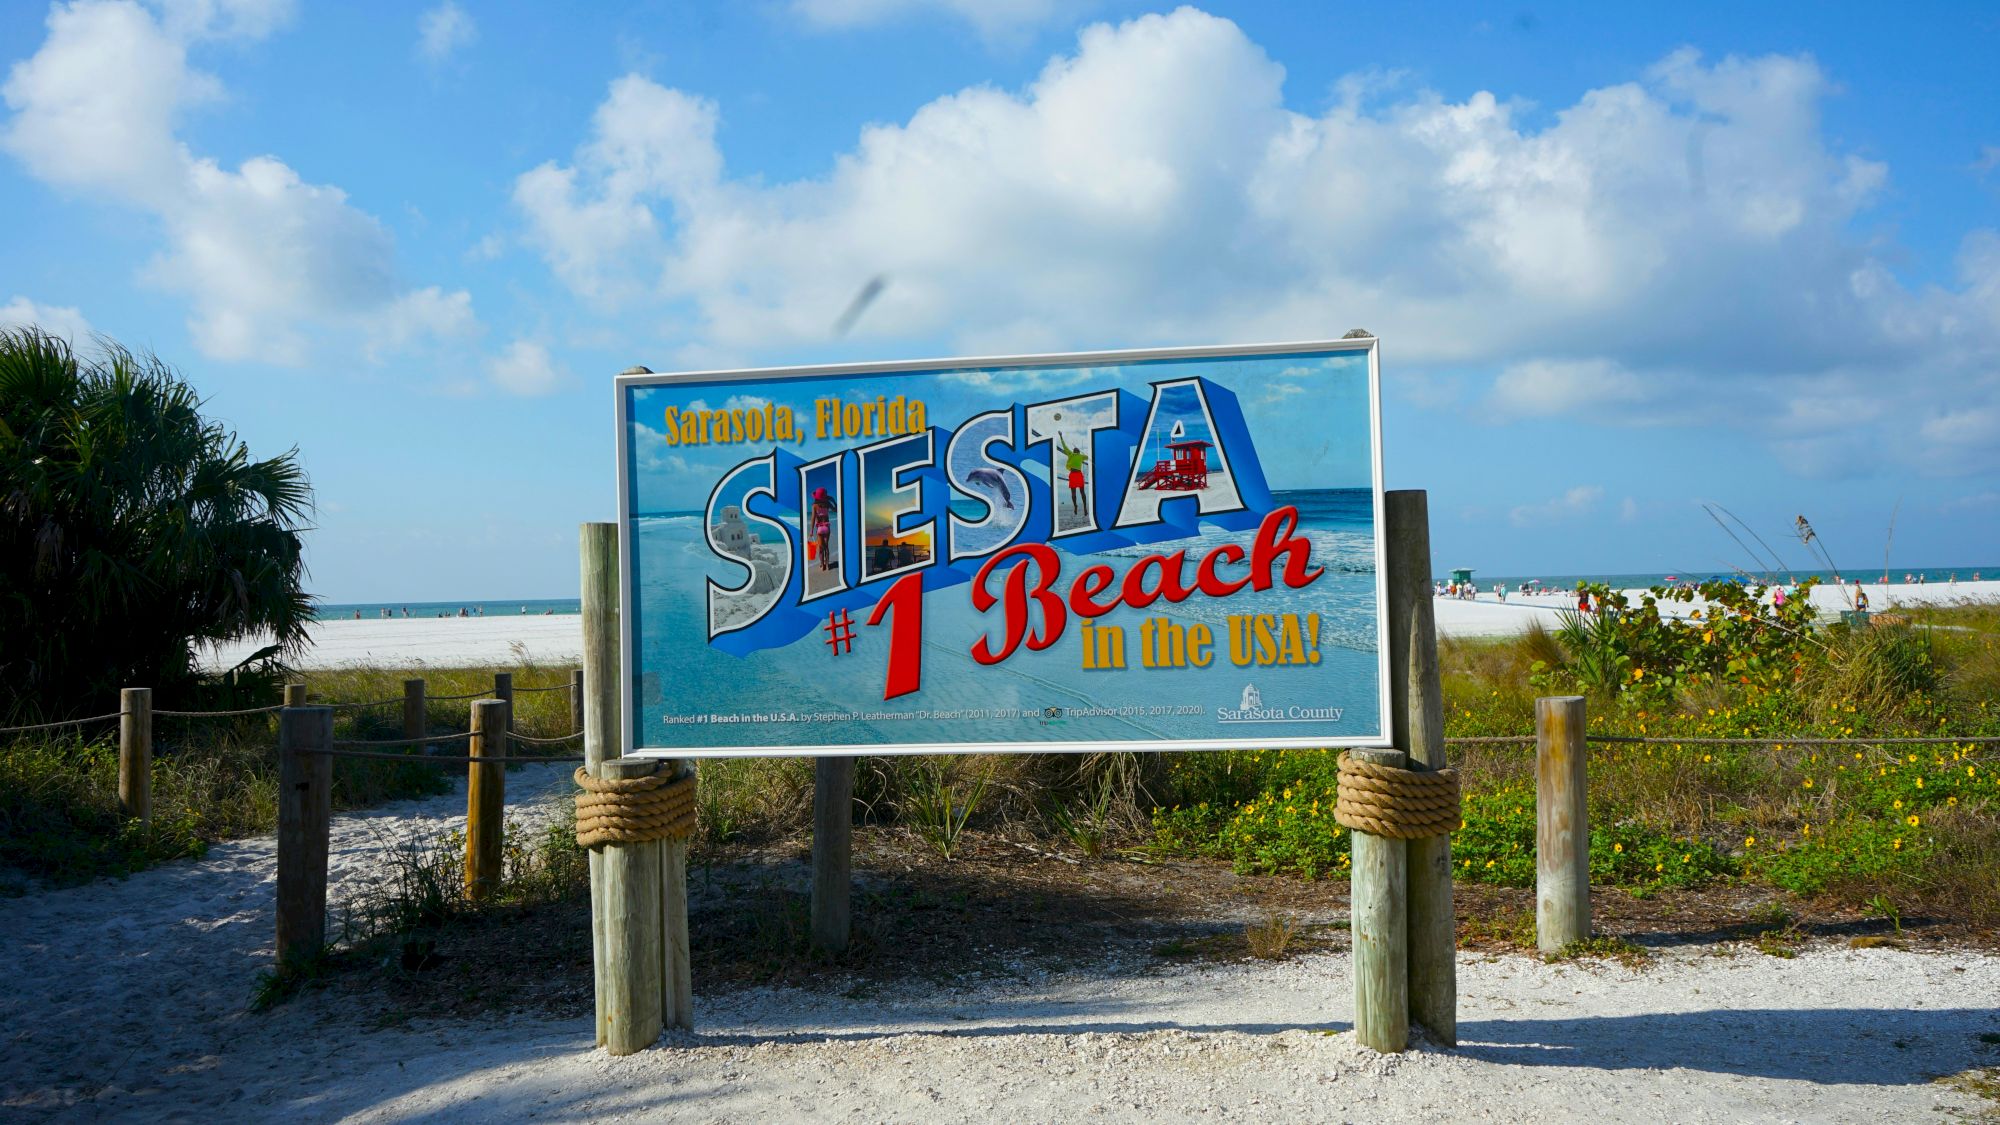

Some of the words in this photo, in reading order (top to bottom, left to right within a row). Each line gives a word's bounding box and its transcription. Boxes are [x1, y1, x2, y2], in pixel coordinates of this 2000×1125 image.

[664, 402, 804, 446] Sarasota,
[815, 395, 927, 438] Florida
[704, 375, 1250, 644] SIESTA
[823, 571, 923, 701] #1
[970, 504, 1325, 666] Beach
[1081, 618, 1126, 670] in
[1140, 616, 1213, 669] the
[1227, 612, 1321, 668] USA!
[663, 714, 695, 724] Ranked
[697, 714, 708, 724] #1
[710, 713, 740, 723] Beach
[741, 713, 751, 723] in
[752, 713, 769, 723] the
[770, 712, 800, 722] U.S.A.
[801, 712, 812, 723] by
[813, 712, 851, 723] Stephen
[852, 711, 859, 721] P.
[861, 711, 915, 720] Leatherman
[965, 709, 993, 720] (2011,
[994, 708, 1020, 719] 2017)
[1022, 708, 1040, 718] and
[1065, 707, 1117, 718] TripAdvisor
[1119, 706, 1148, 716] (2015,
[1150, 706, 1175, 716] 2017,
[1177, 704, 1206, 715] 2020).
[1217, 706, 1286, 720] Sarasota
[1289, 705, 1344, 721] County
